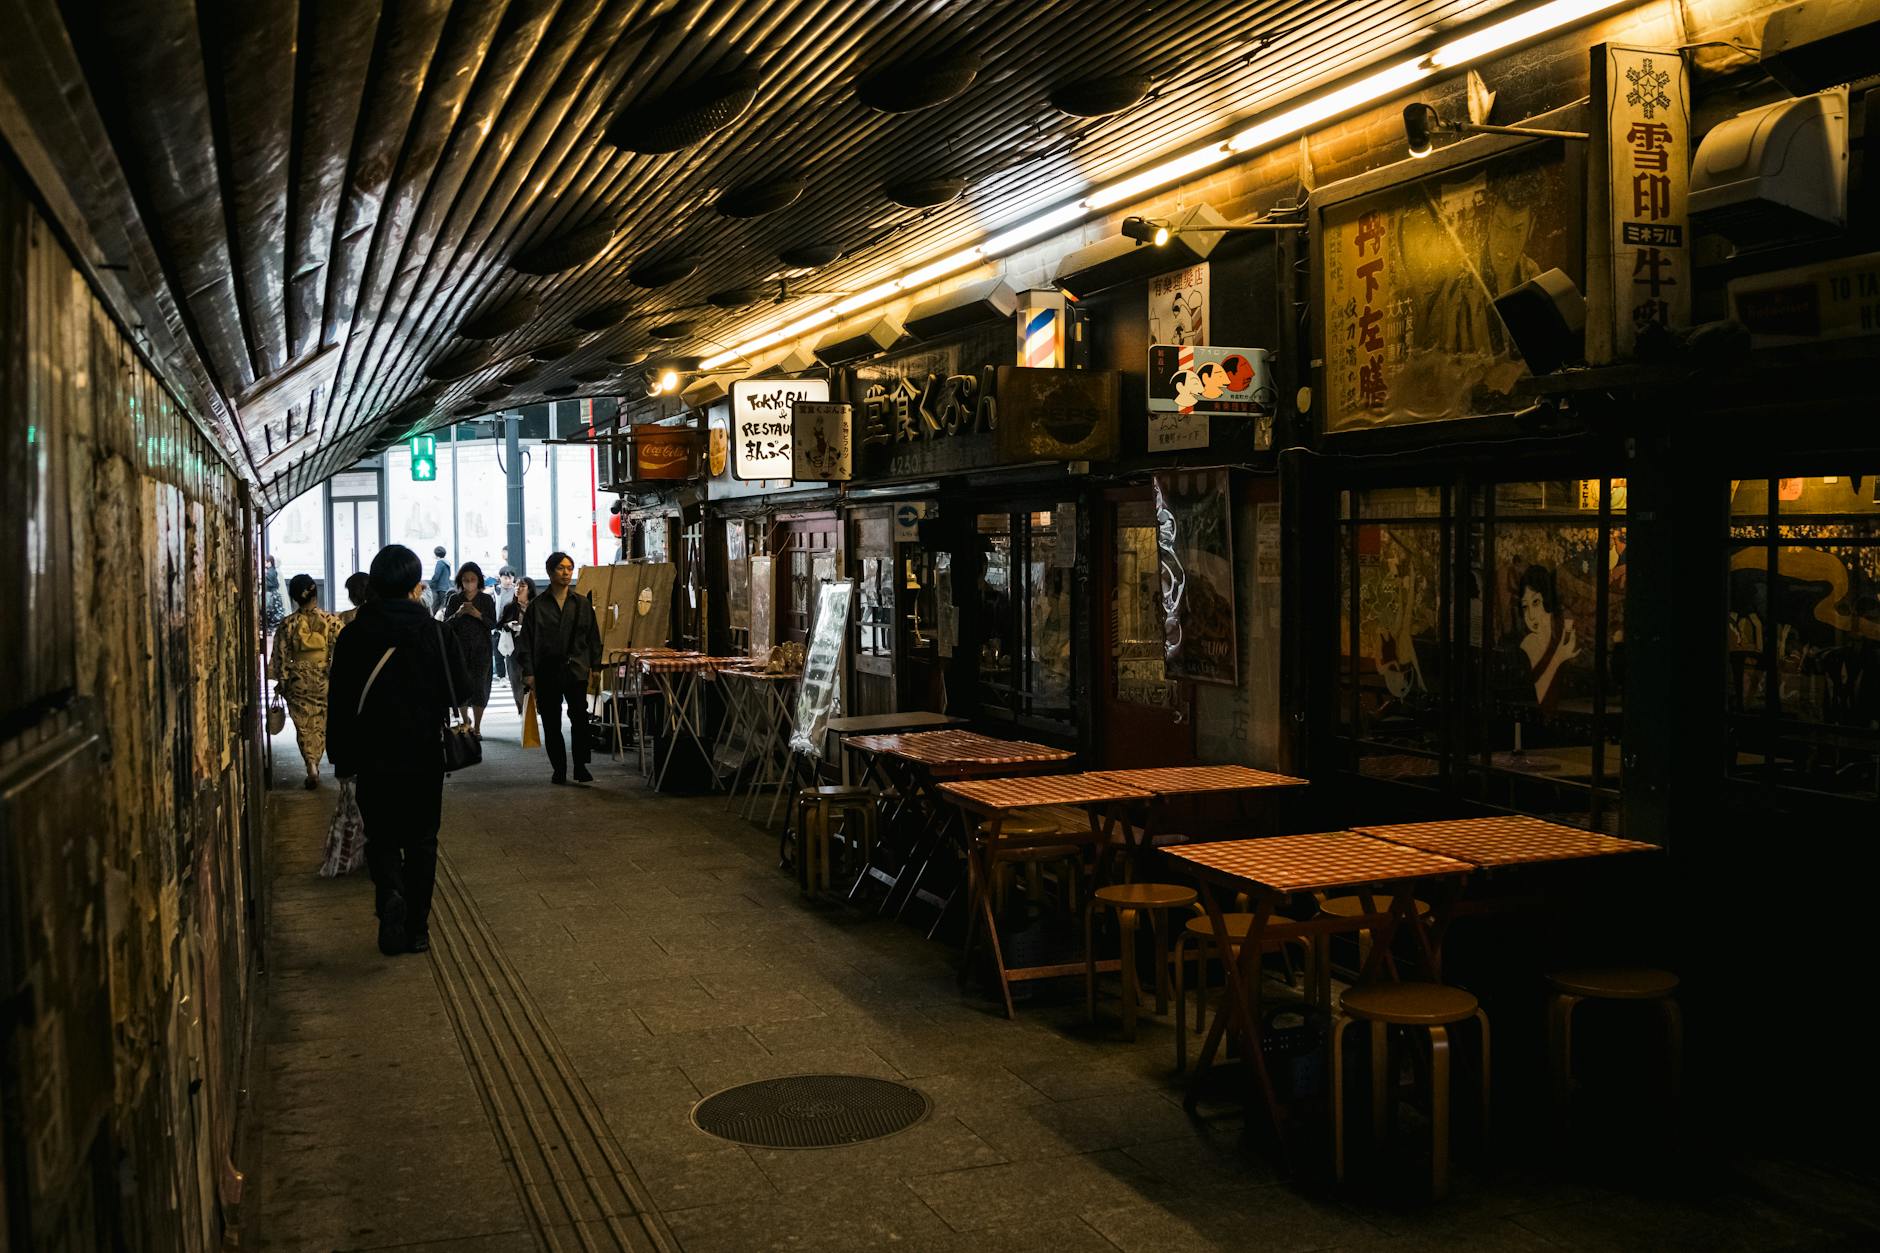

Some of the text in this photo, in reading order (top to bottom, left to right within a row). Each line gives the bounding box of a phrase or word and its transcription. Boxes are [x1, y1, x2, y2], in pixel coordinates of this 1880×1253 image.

[1626, 122, 1673, 221] 雪印
[1627, 225, 1679, 245] ミネラル
[1829, 277, 1851, 302] TO
